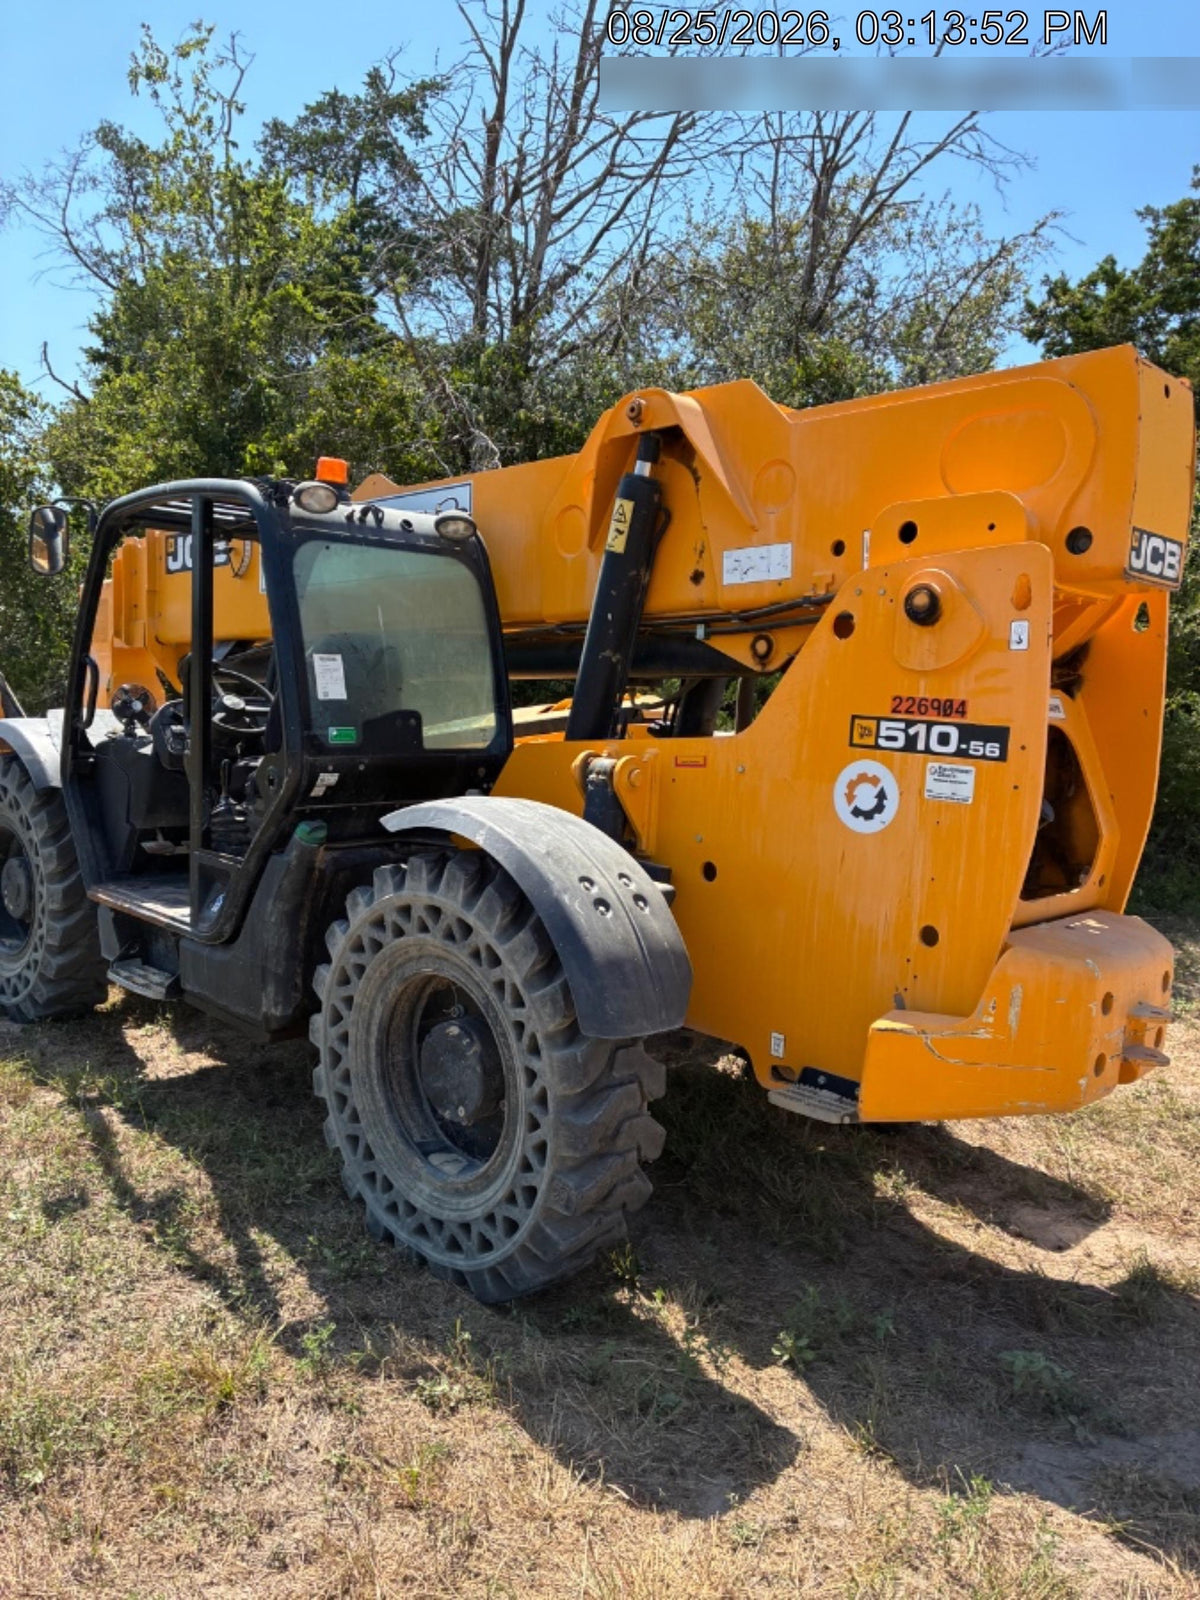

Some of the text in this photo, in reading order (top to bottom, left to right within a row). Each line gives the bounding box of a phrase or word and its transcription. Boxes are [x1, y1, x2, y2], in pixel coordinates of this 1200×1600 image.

[1131, 534, 1181, 578] JCB
[891, 696, 967, 718] 226904
[877, 720, 1001, 757] 510-56
